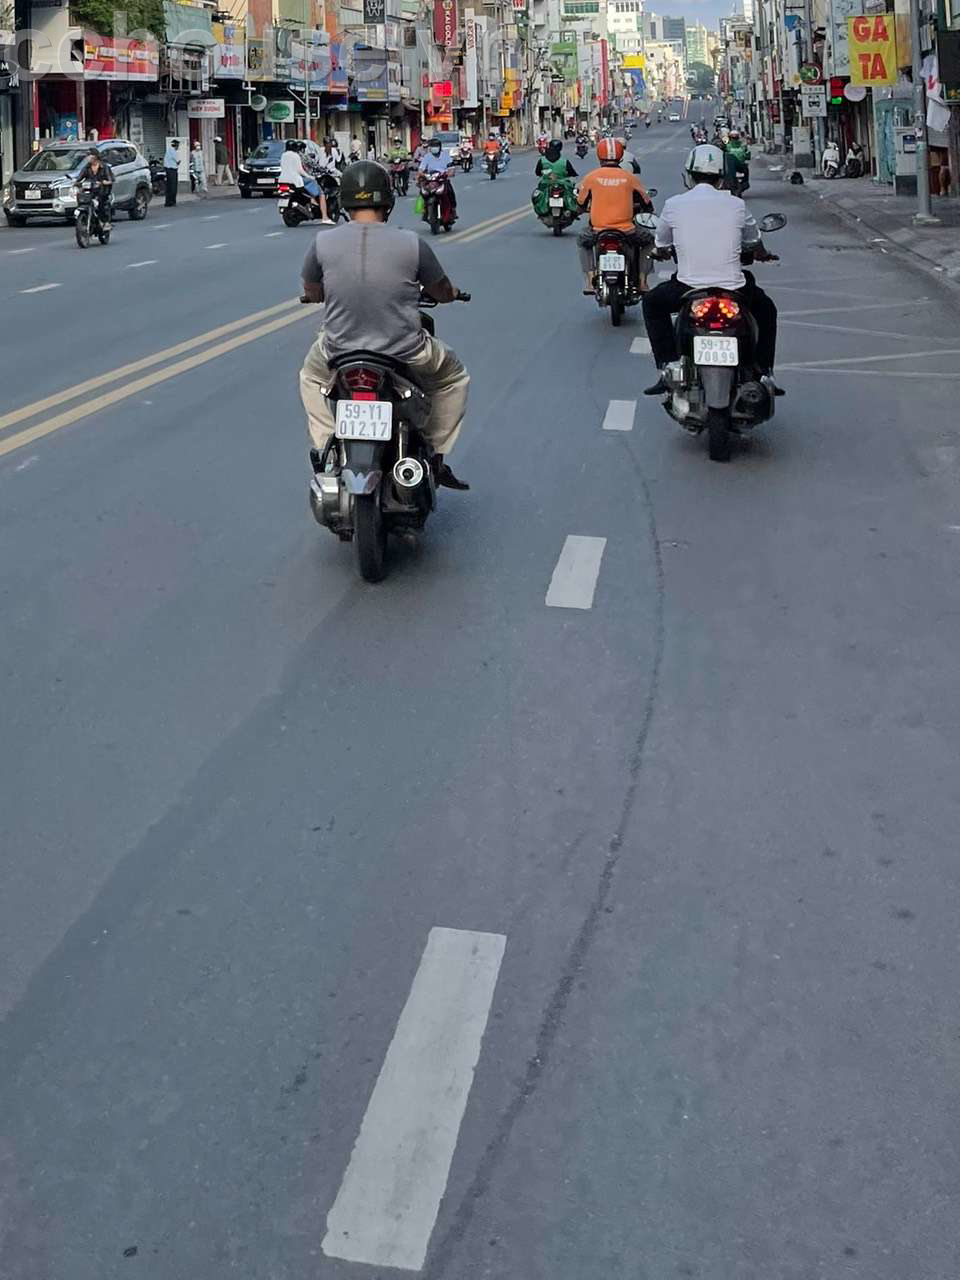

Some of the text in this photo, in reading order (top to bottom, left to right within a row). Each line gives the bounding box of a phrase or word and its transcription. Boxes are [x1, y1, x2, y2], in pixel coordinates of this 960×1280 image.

[853, 16, 889, 42] GA
[858, 53, 888, 80] TA
[345, 403, 382, 420] 59-Y1
[340, 420, 388, 437] 012.17
